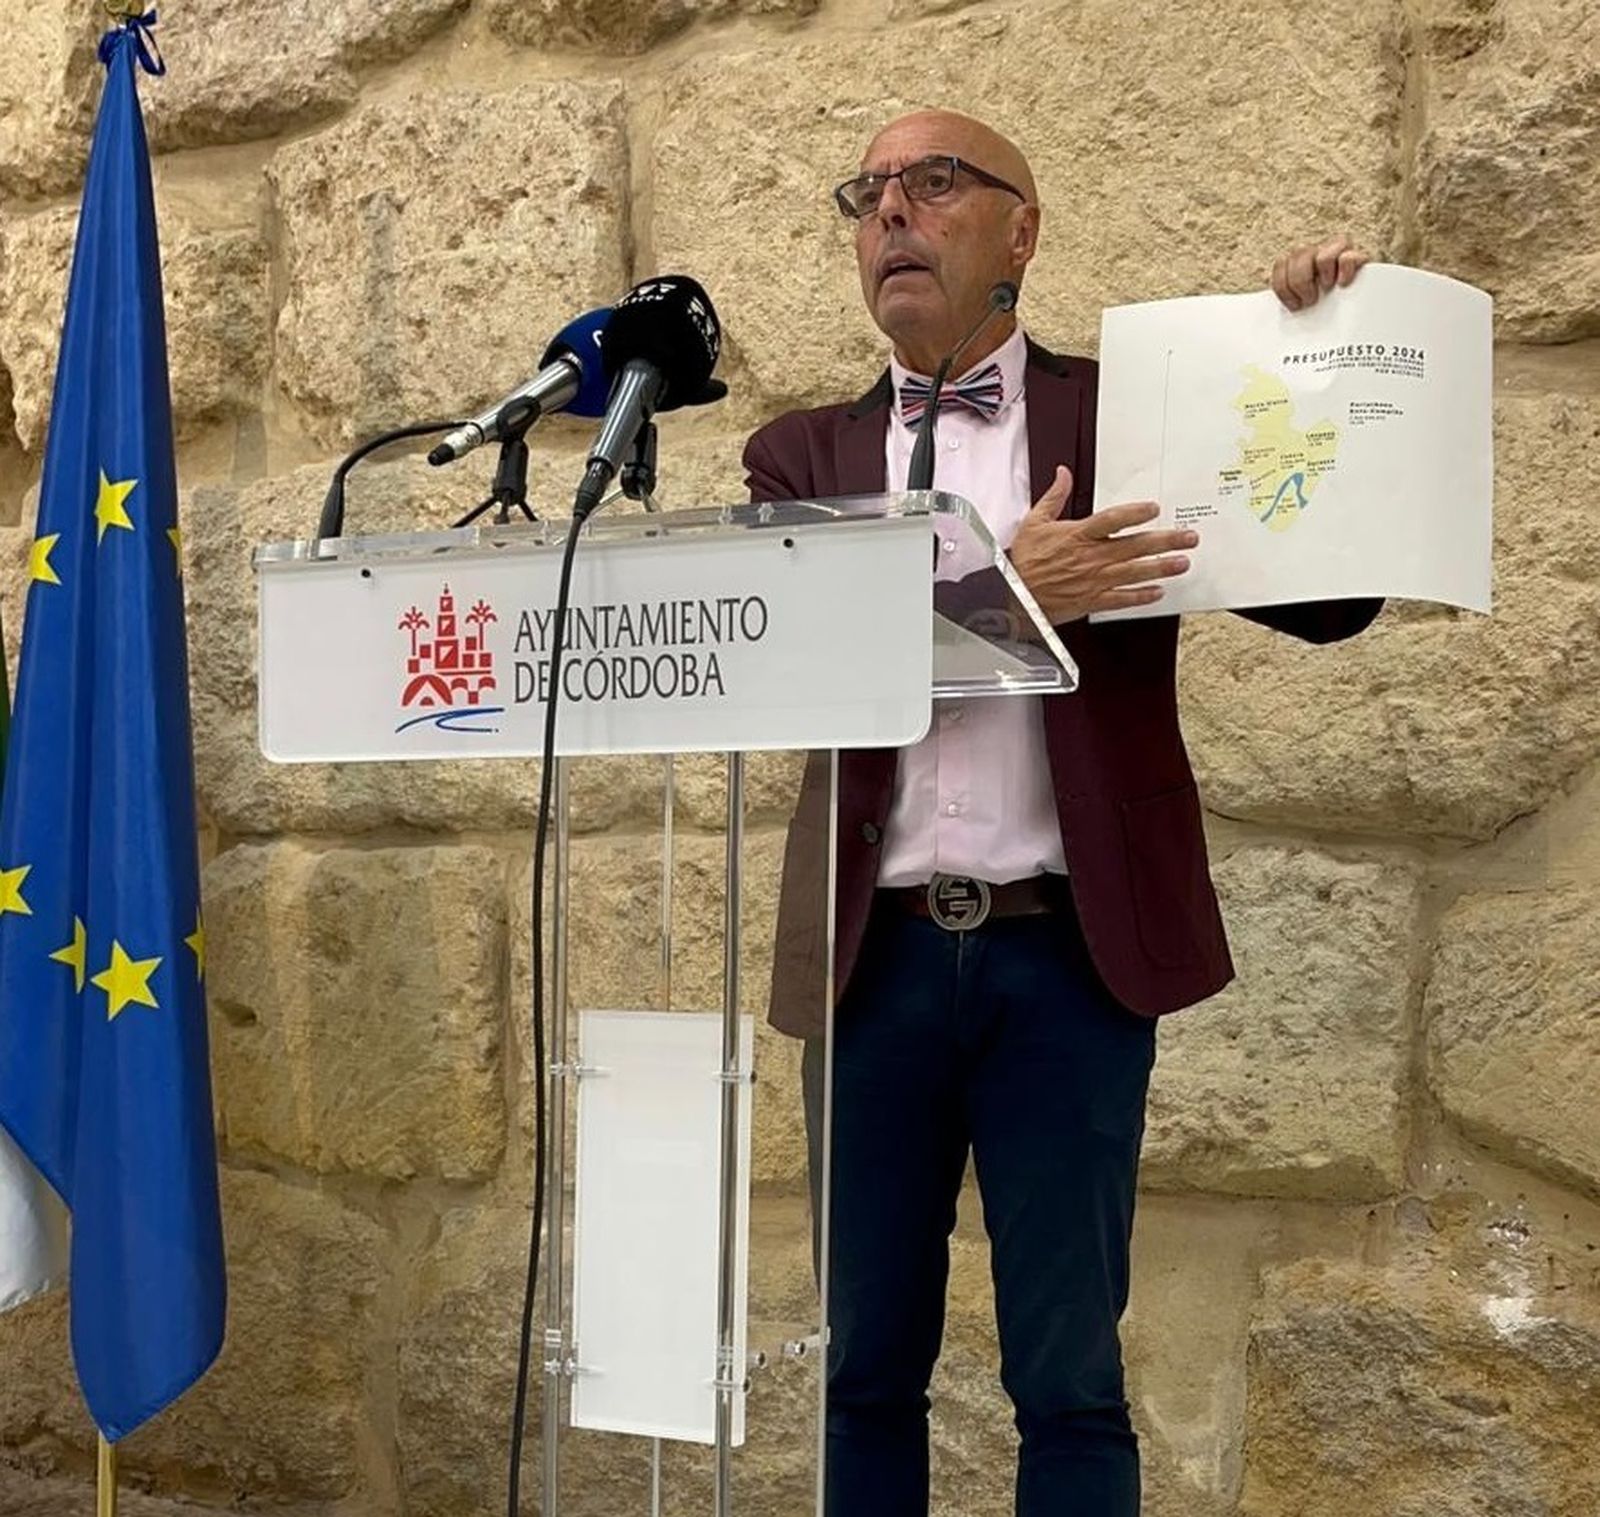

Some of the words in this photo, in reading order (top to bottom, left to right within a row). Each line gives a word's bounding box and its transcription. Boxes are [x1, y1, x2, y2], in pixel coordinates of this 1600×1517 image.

[1282, 344, 1385, 364] PRESUPUESTO
[1392, 345, 1425, 361] 2024
[513, 596, 768, 653] AYUNTAMIENTO
[513, 660, 551, 703] DE
[562, 650, 726, 702] CÓRDOBA
